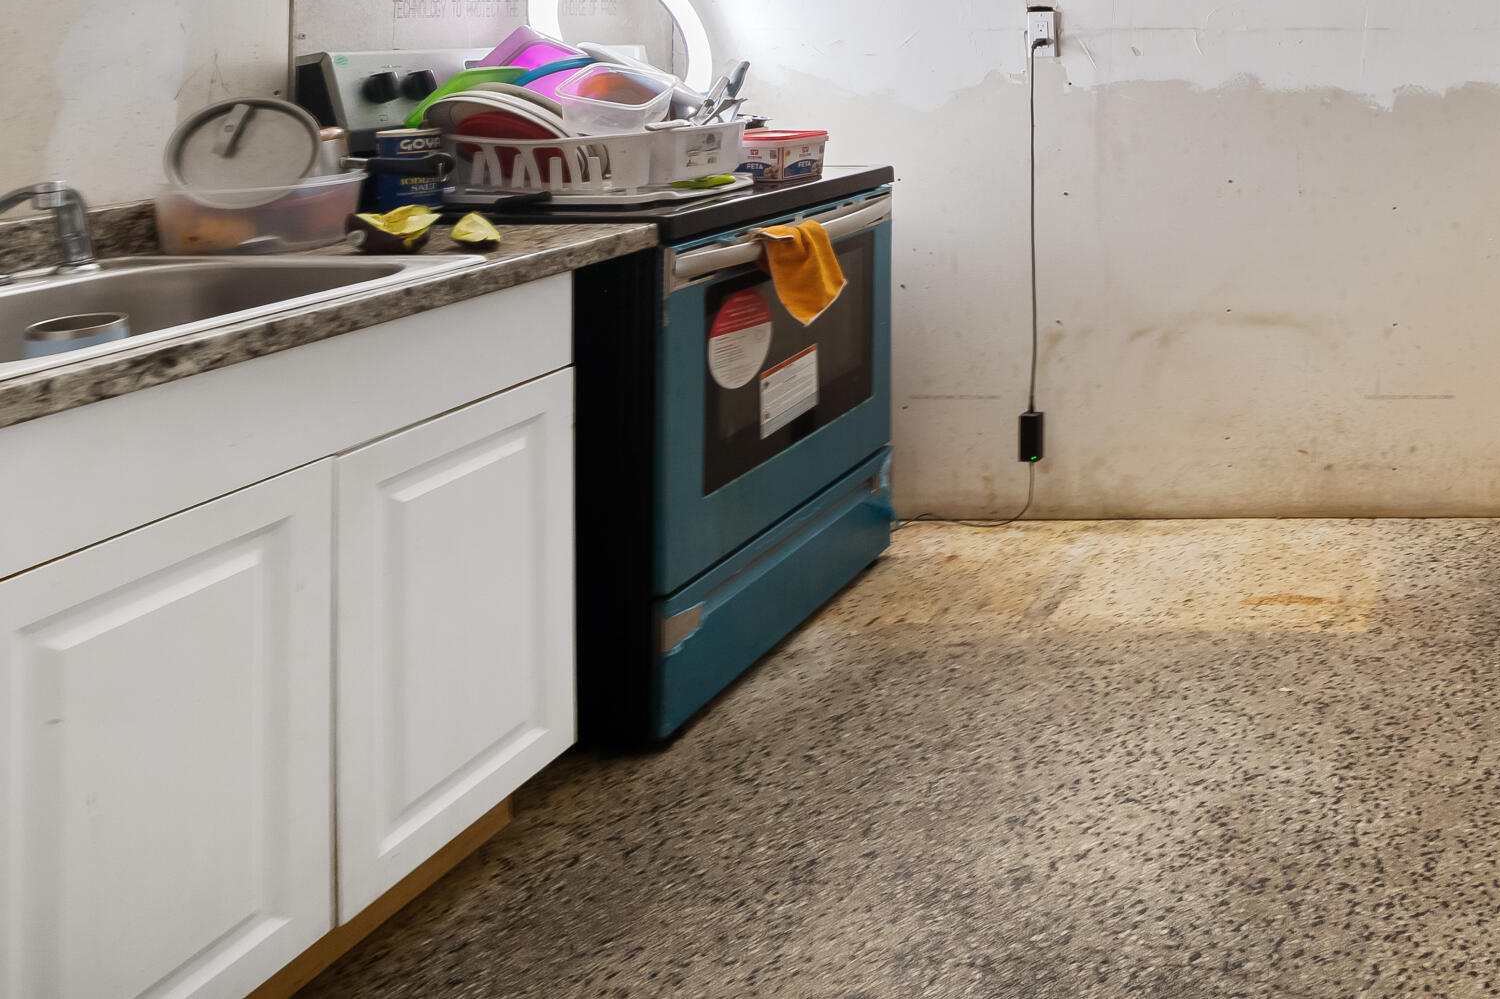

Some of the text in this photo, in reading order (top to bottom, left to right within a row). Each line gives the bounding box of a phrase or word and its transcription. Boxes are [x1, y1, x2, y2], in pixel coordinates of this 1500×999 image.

[392, 0, 446, 19] TECHNOLOGY
[450, 0, 462, 18] TO
[465, 0, 501, 18] PROTECT
[411, 183, 437, 192] SALT
